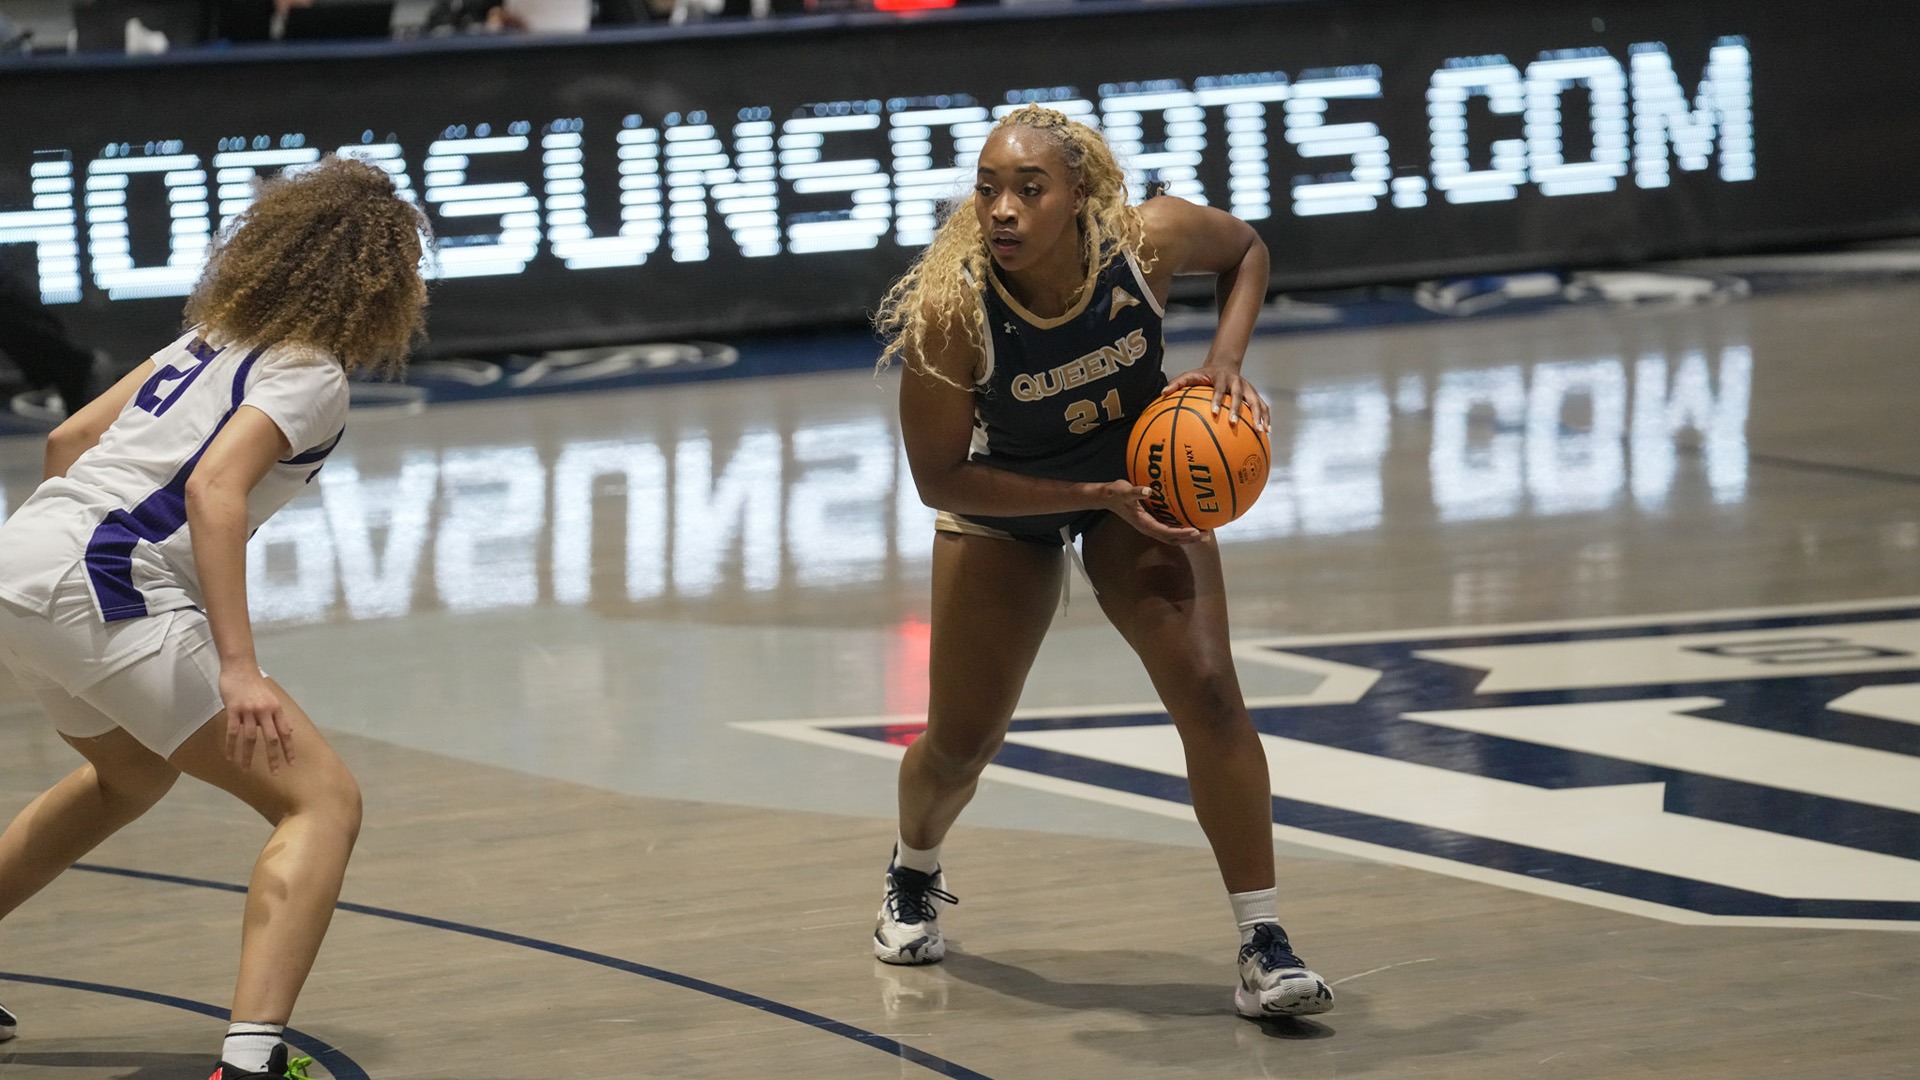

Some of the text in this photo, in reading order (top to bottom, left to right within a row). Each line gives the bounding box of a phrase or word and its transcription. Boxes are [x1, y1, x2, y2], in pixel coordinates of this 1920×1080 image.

[1011, 328, 1148, 402] QUEENS
[1064, 388, 1125, 434] 21
[1184, 443, 1195, 462] NXT
